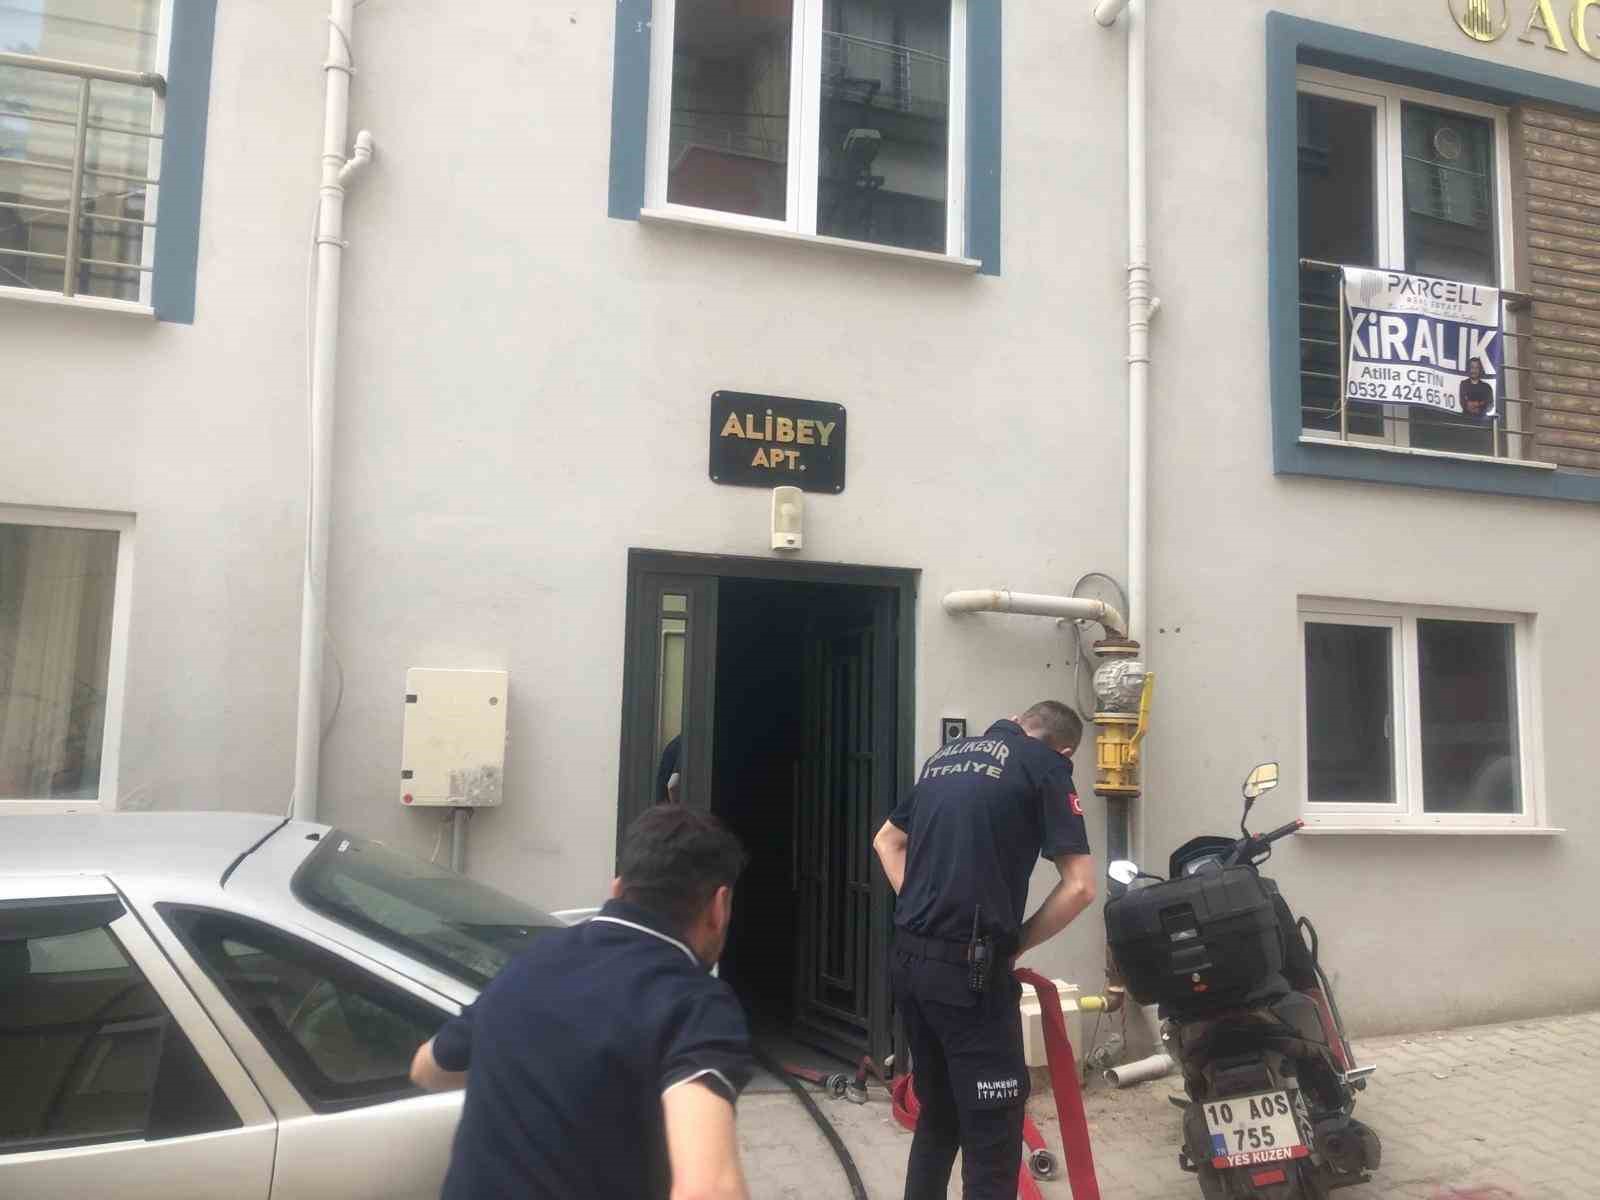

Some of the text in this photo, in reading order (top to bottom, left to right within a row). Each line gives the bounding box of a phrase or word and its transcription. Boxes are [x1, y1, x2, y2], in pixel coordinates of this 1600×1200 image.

[1388, 274, 1482, 306] PARCELL
[1361, 366, 1401, 381] Atilla
[1349, 381, 1455, 409] 0532 424 65 10
[751, 447, 807, 471] APT.
[1208, 1095, 1289, 1125] 10 AOS
[1233, 1125, 1275, 1151] 755
[1227, 1148, 1292, 1167] YES KUZEN
